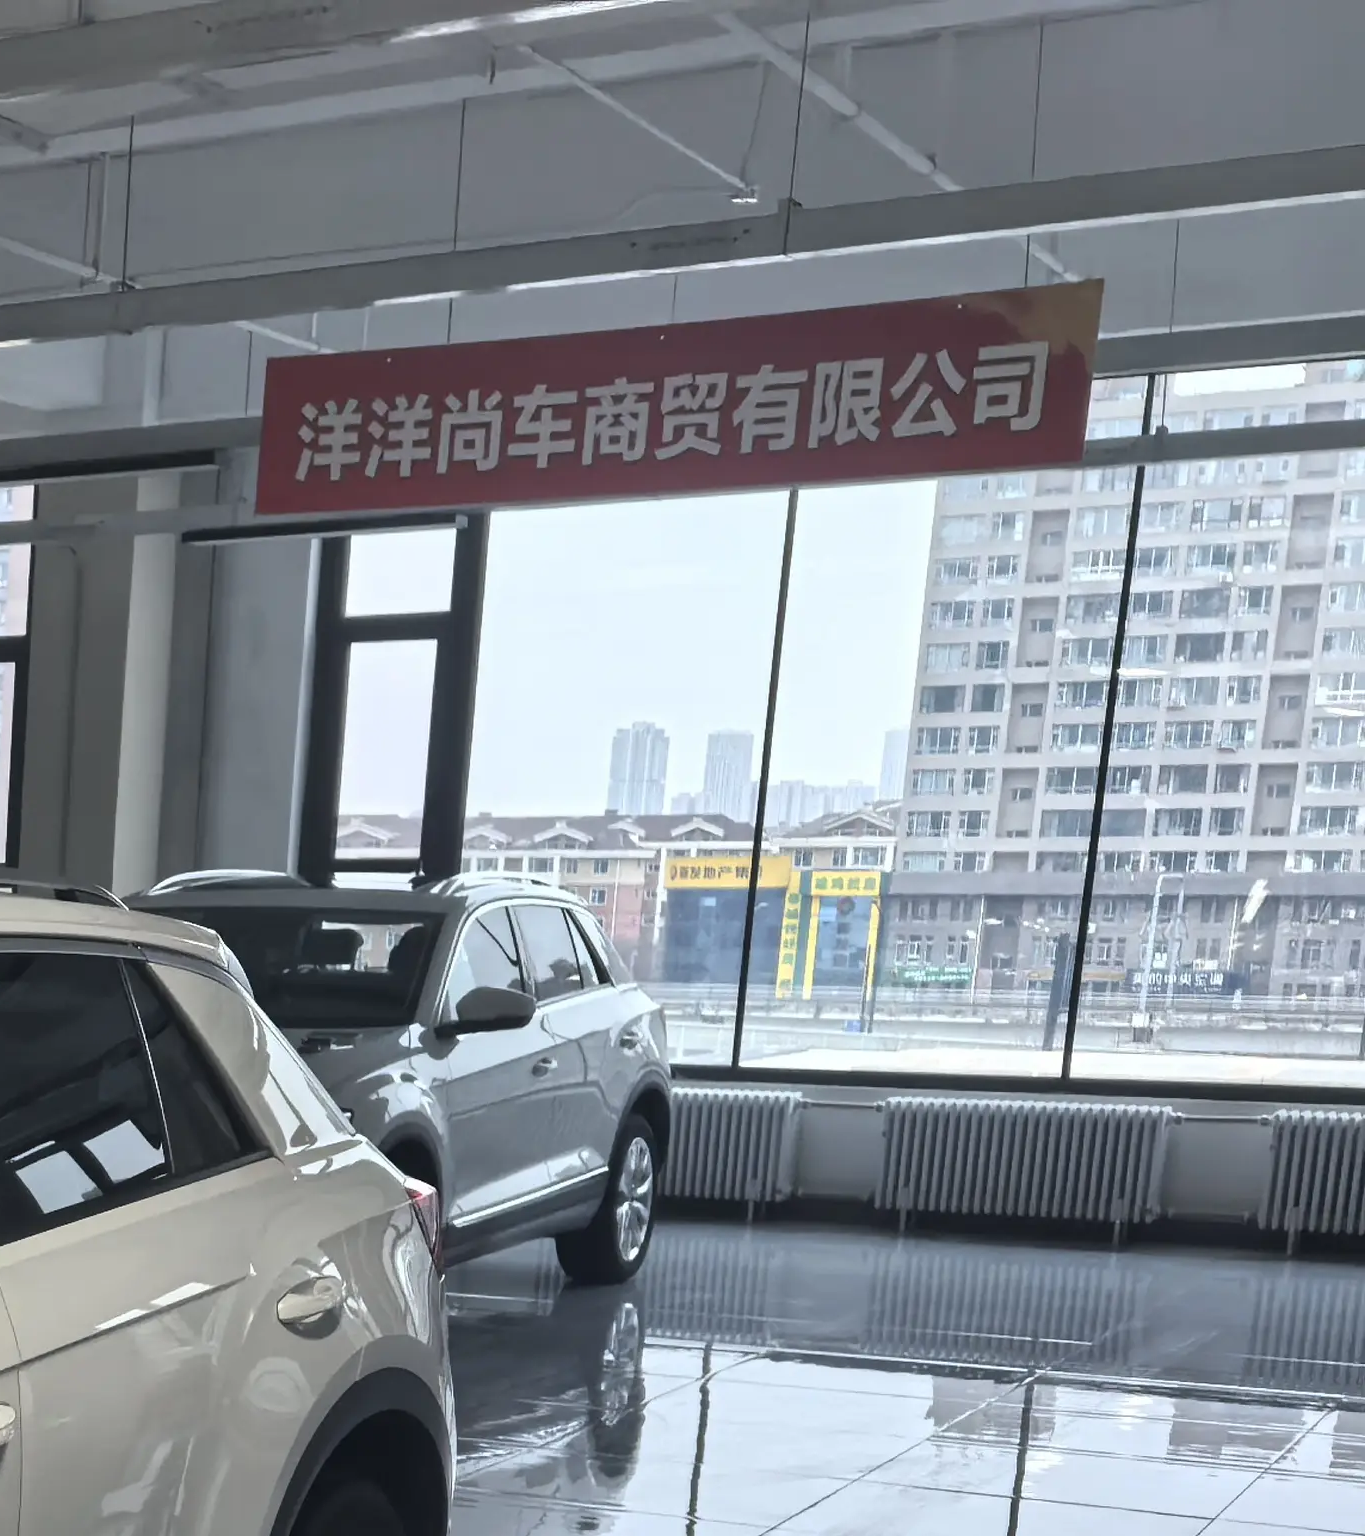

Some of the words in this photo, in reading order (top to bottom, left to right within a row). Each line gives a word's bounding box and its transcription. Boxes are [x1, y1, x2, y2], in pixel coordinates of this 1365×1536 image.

[294, 341, 1050, 482] 洋洋尚车商贸有限公司
